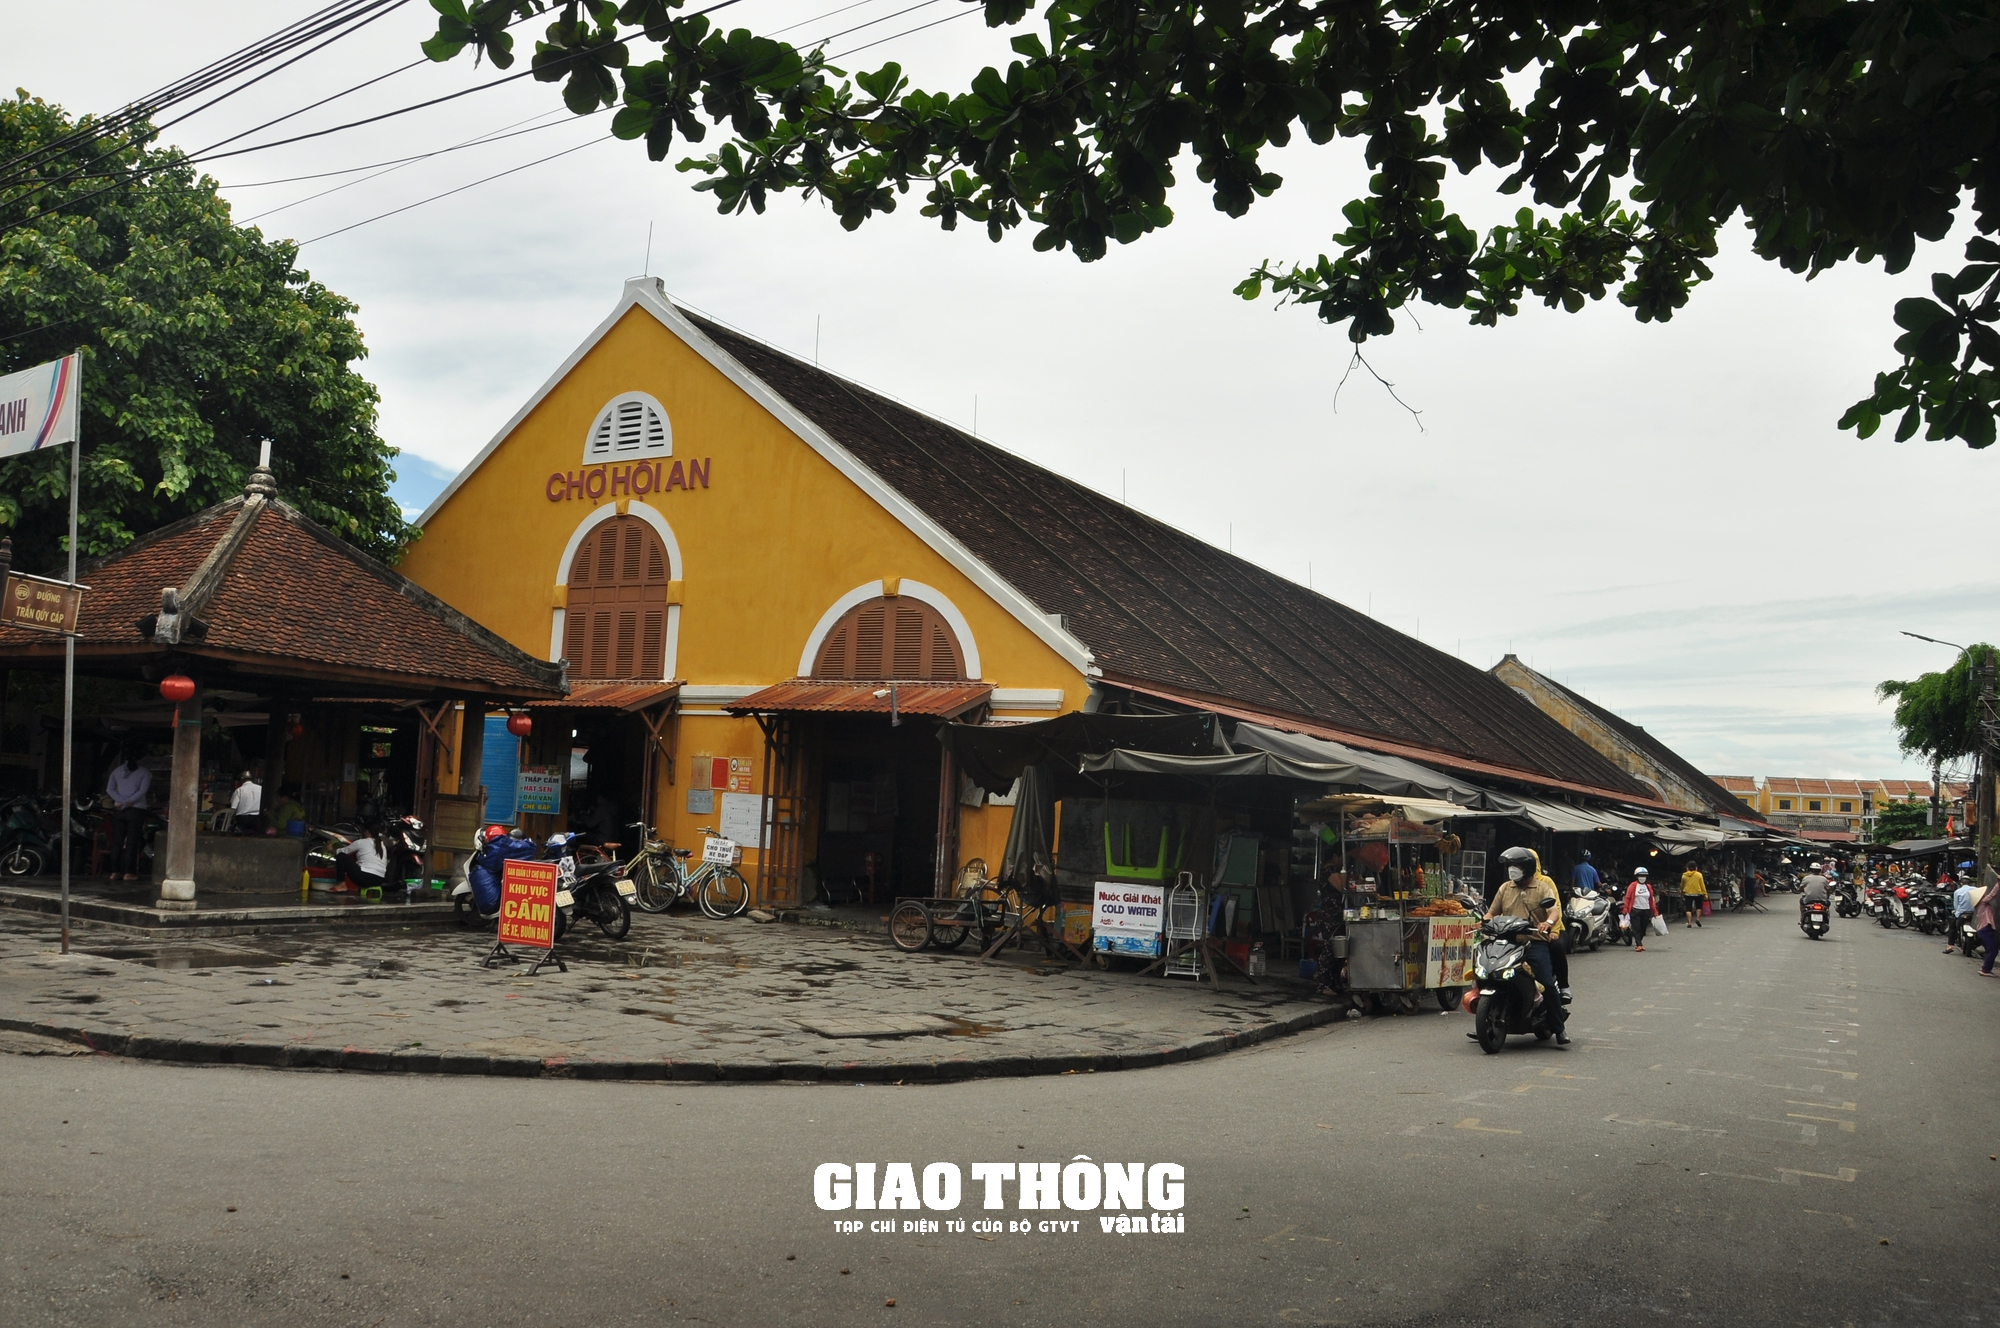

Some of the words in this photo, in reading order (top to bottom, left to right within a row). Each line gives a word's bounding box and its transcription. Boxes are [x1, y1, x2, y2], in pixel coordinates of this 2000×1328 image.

[546, 464, 607, 505] CHỢ
[611, 459, 662, 501] HỘI
[665, 458, 711, 491] AN
[37, 590, 61, 603] ĐƯỜNG
[16, 604, 35, 619] TRẦN
[50, 611, 64, 624] CÁP
[509, 883, 528, 895] KHU
[530, 885, 548, 898] VỰC
[1142, 894, 1161, 905] Khát
[504, 896, 550, 923] CẤM
[1101, 904, 1124, 914] COLD
[1128, 906, 1157, 917] WATER
[537, 925, 549, 940] BÁN
